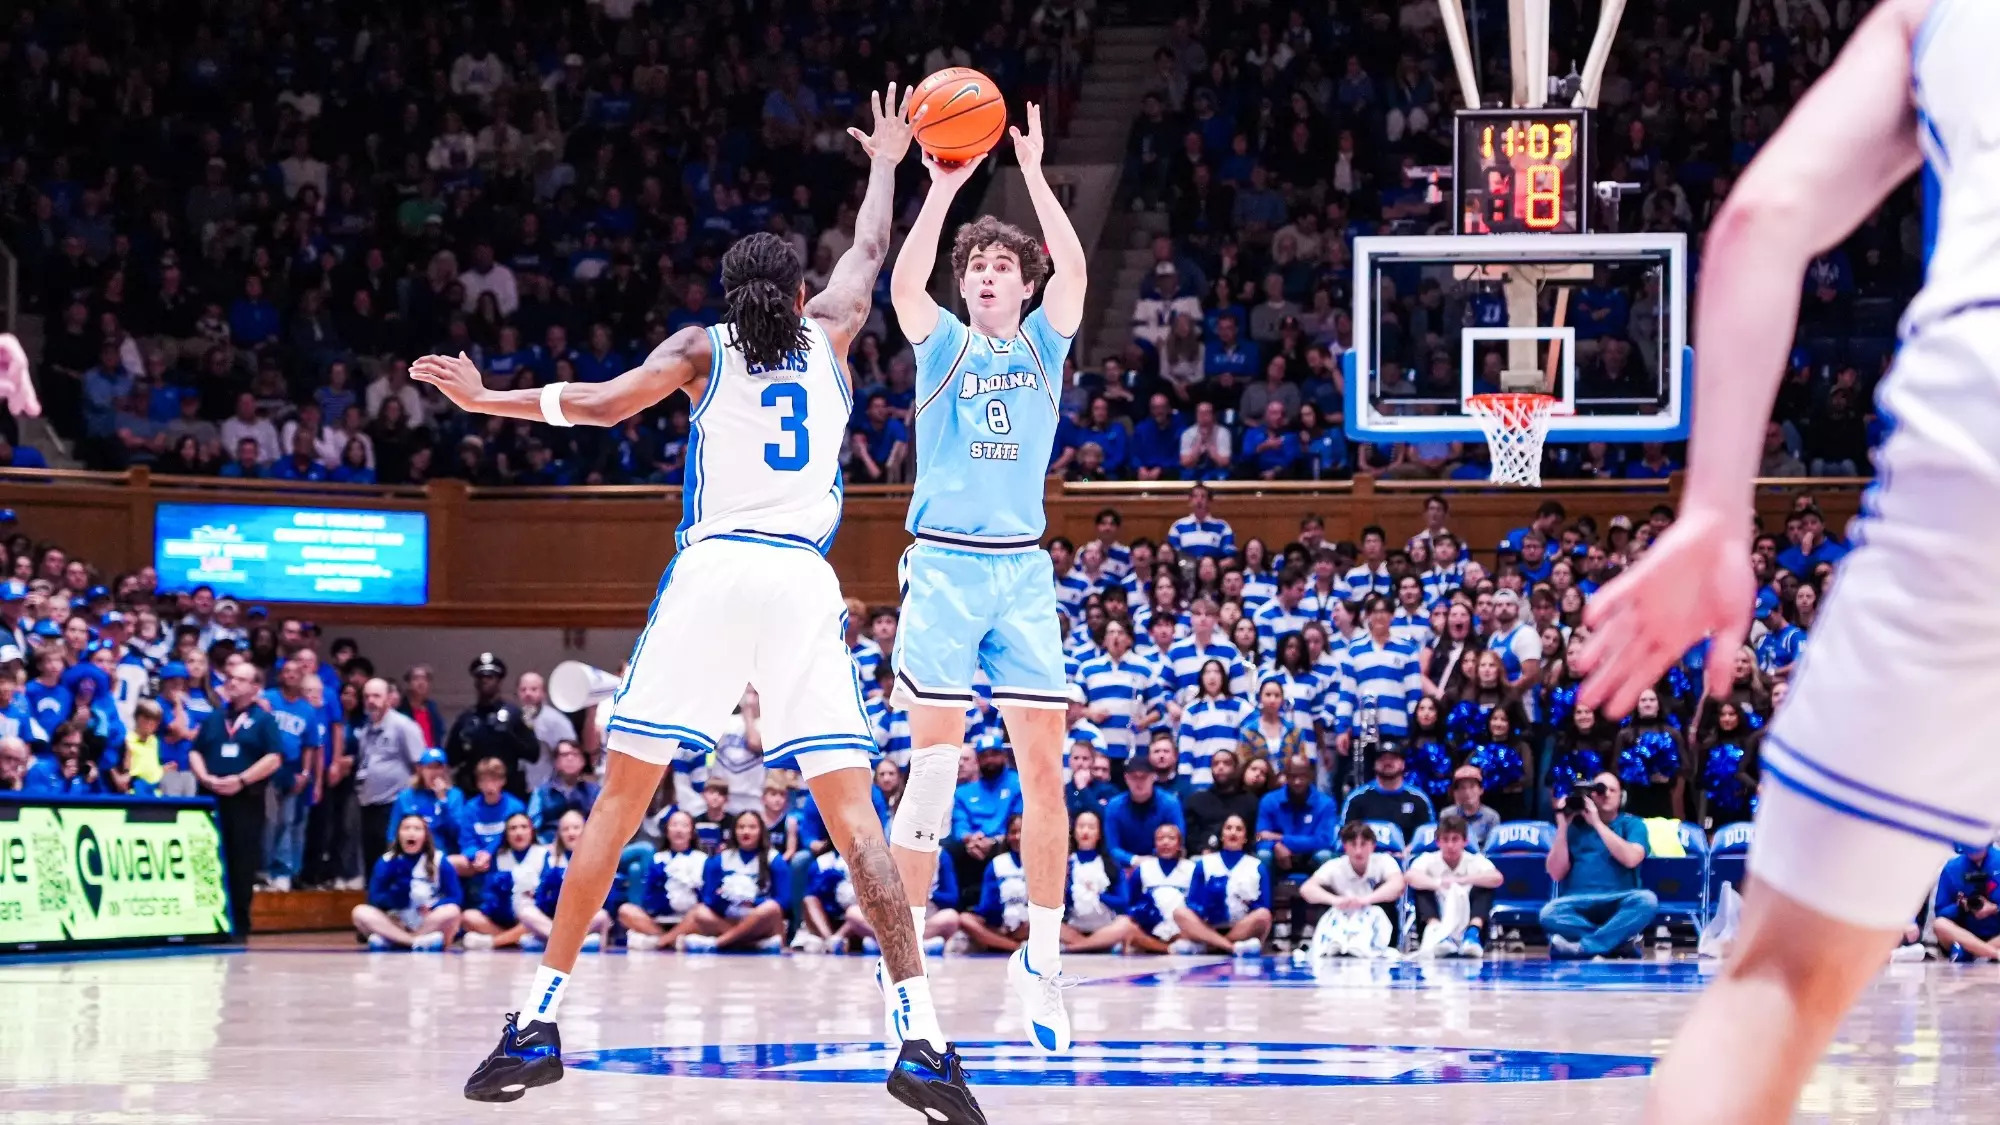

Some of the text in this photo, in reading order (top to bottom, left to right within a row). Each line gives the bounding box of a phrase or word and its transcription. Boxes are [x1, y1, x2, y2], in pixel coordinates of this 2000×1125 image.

[1482, 123, 1573, 160] 11:03
[1525, 164, 1562, 229] 8
[761, 382, 810, 472] 3
[986, 399, 1012, 435] 8
[969, 441, 1020, 461] STATE
[1499, 824, 1540, 846] DUKE
[106, 838, 186, 882] wave
